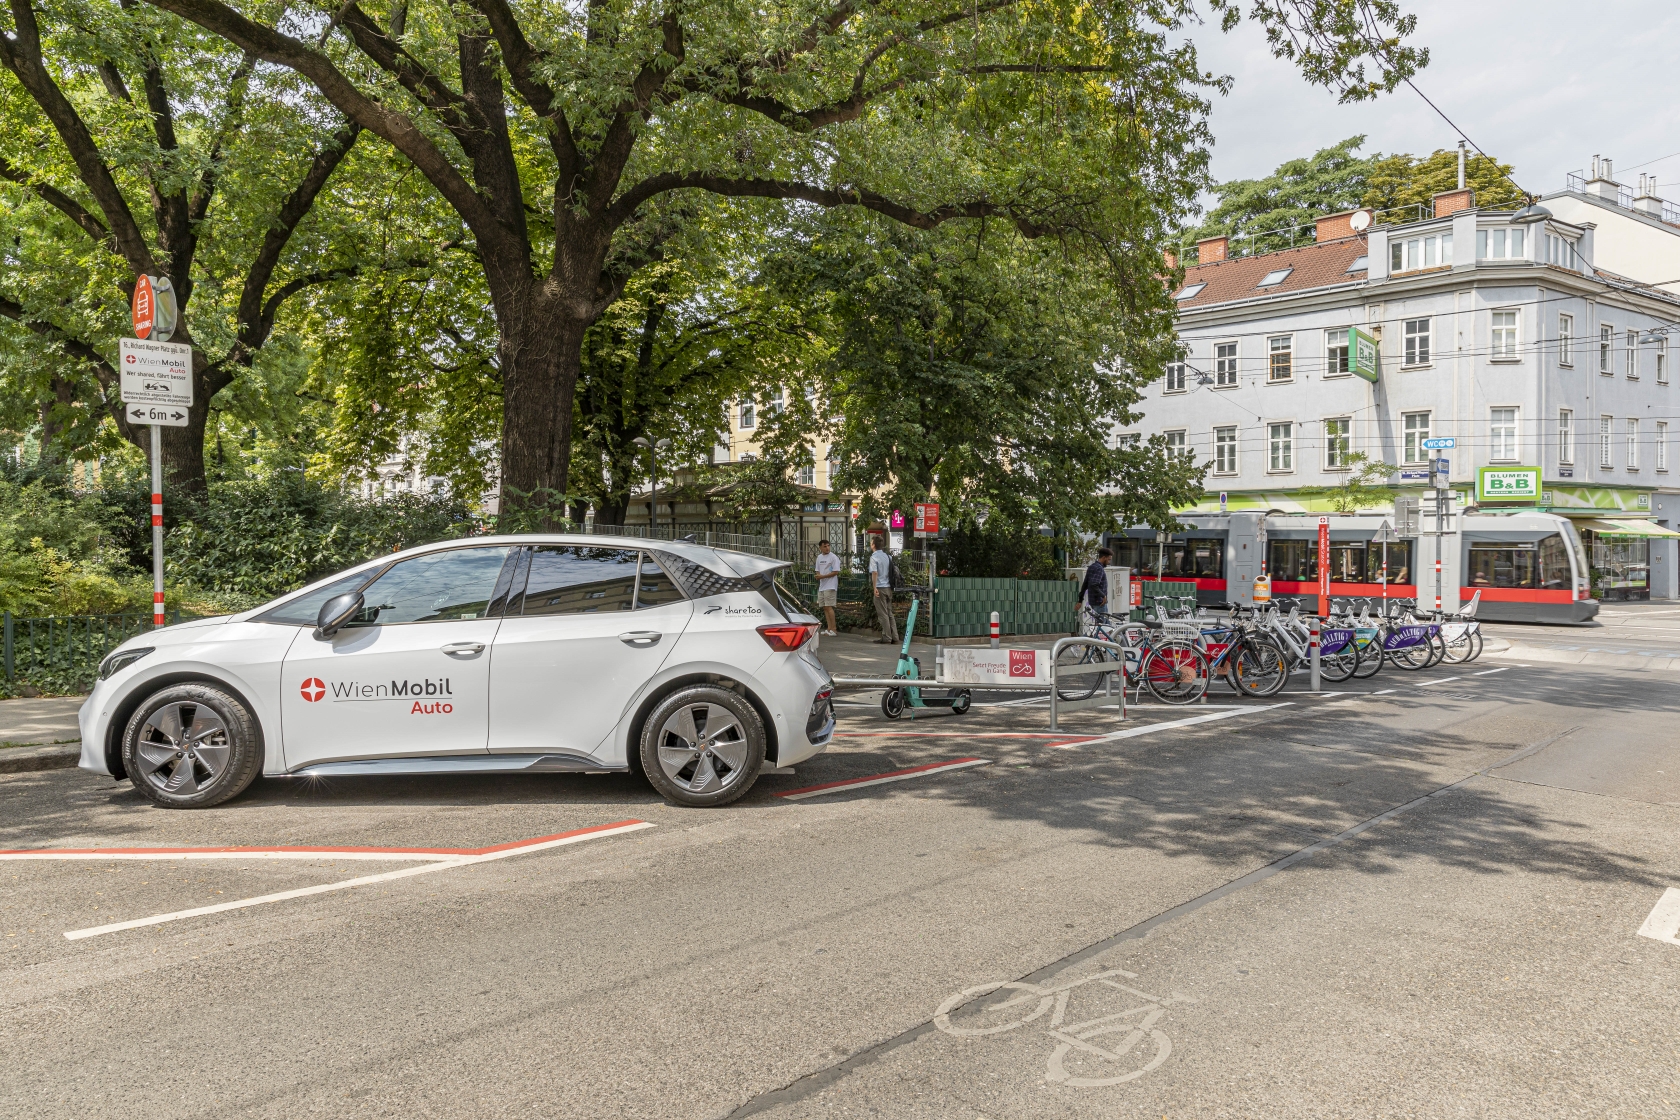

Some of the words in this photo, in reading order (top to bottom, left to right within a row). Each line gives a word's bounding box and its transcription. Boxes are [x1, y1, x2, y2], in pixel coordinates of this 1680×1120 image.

[136, 320, 152, 330] SHARING
[146, 344, 160, 352] Wagner
[138, 357, 186, 367] WienMobil
[149, 408, 167, 420] 6m
[1490, 479, 1529, 489] B&B
[725, 605, 762, 614] sharetoo
[331, 678, 453, 698] WienMobil
[411, 701, 453, 714] Auto
